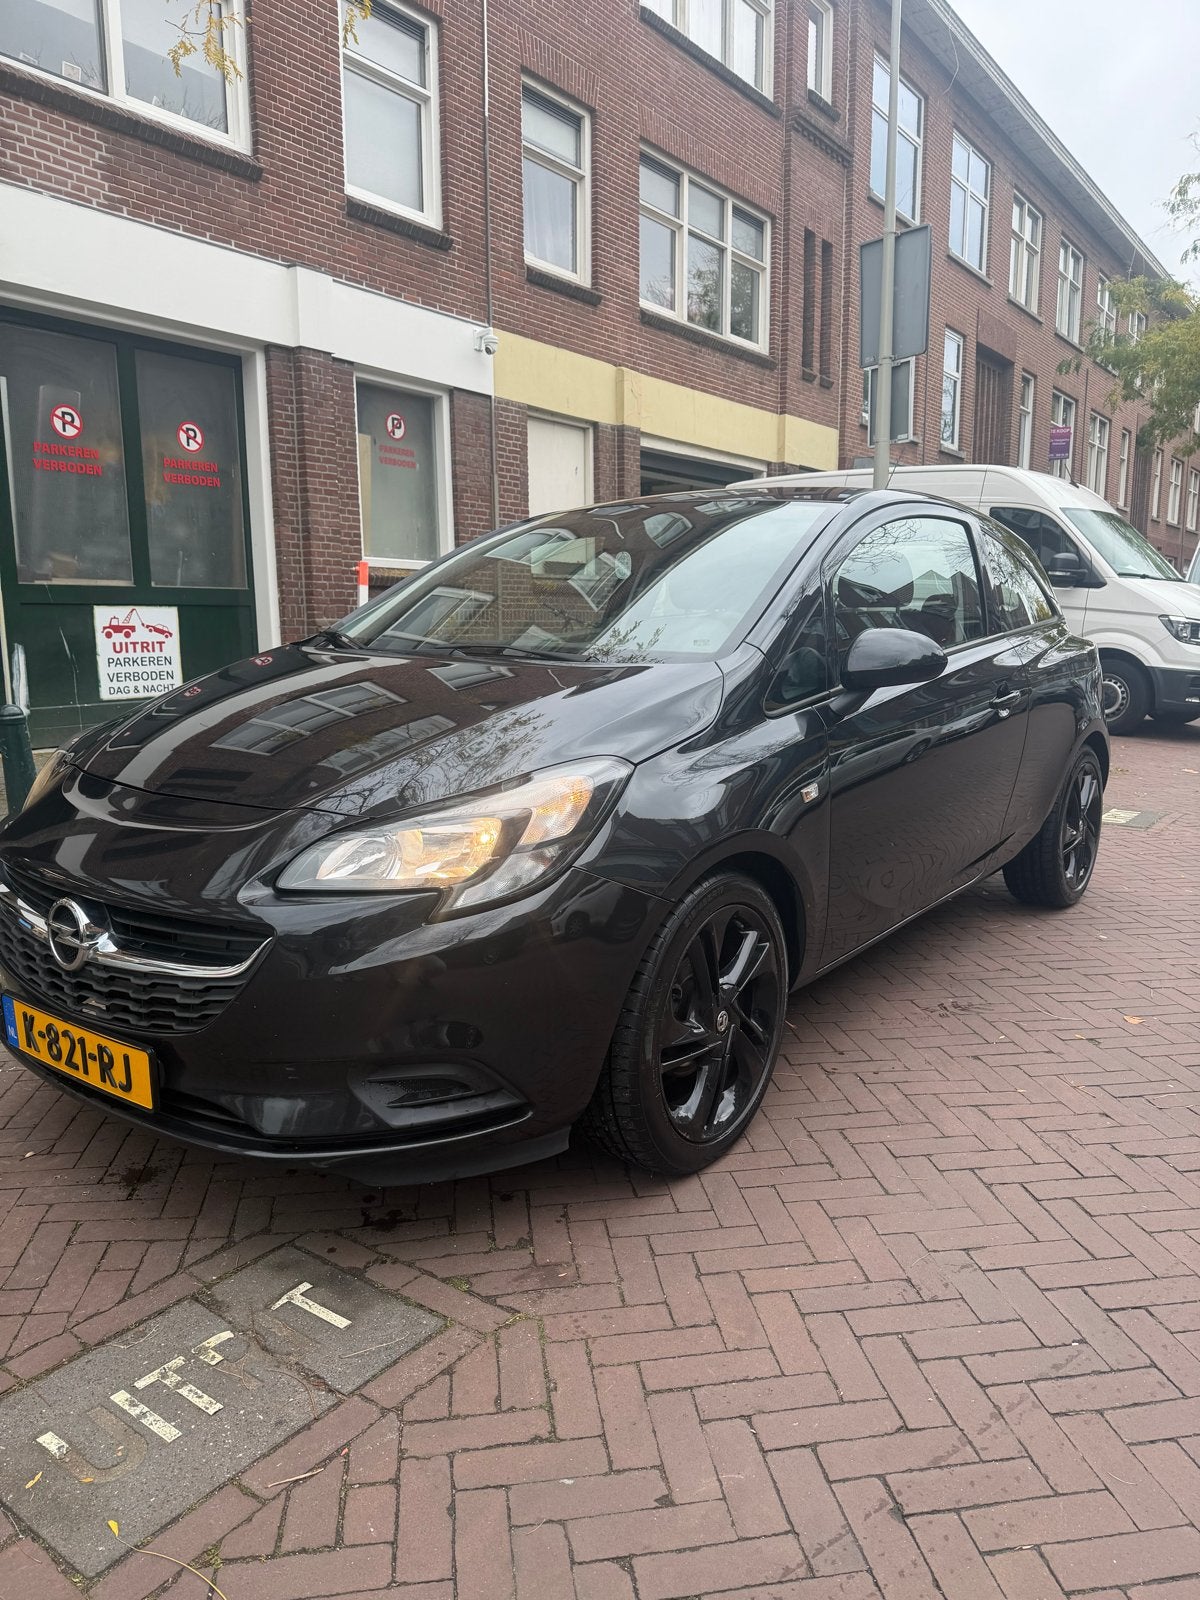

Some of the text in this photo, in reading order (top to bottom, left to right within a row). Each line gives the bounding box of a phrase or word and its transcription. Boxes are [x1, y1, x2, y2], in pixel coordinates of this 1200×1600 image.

[33, 441, 99, 460] PARKEREN
[32, 458, 103, 476] VERBODEN
[163, 457, 219, 473] PARKEREN
[163, 472, 221, 488] VERBODEN
[112, 641, 166, 654] UITRIT
[107, 656, 172, 668] PARKEREN
[107, 670, 175, 683] VERBODEN
[108, 683, 176, 695] DAG & NACHT
[22, 1010, 133, 1093] K-821-RJ
